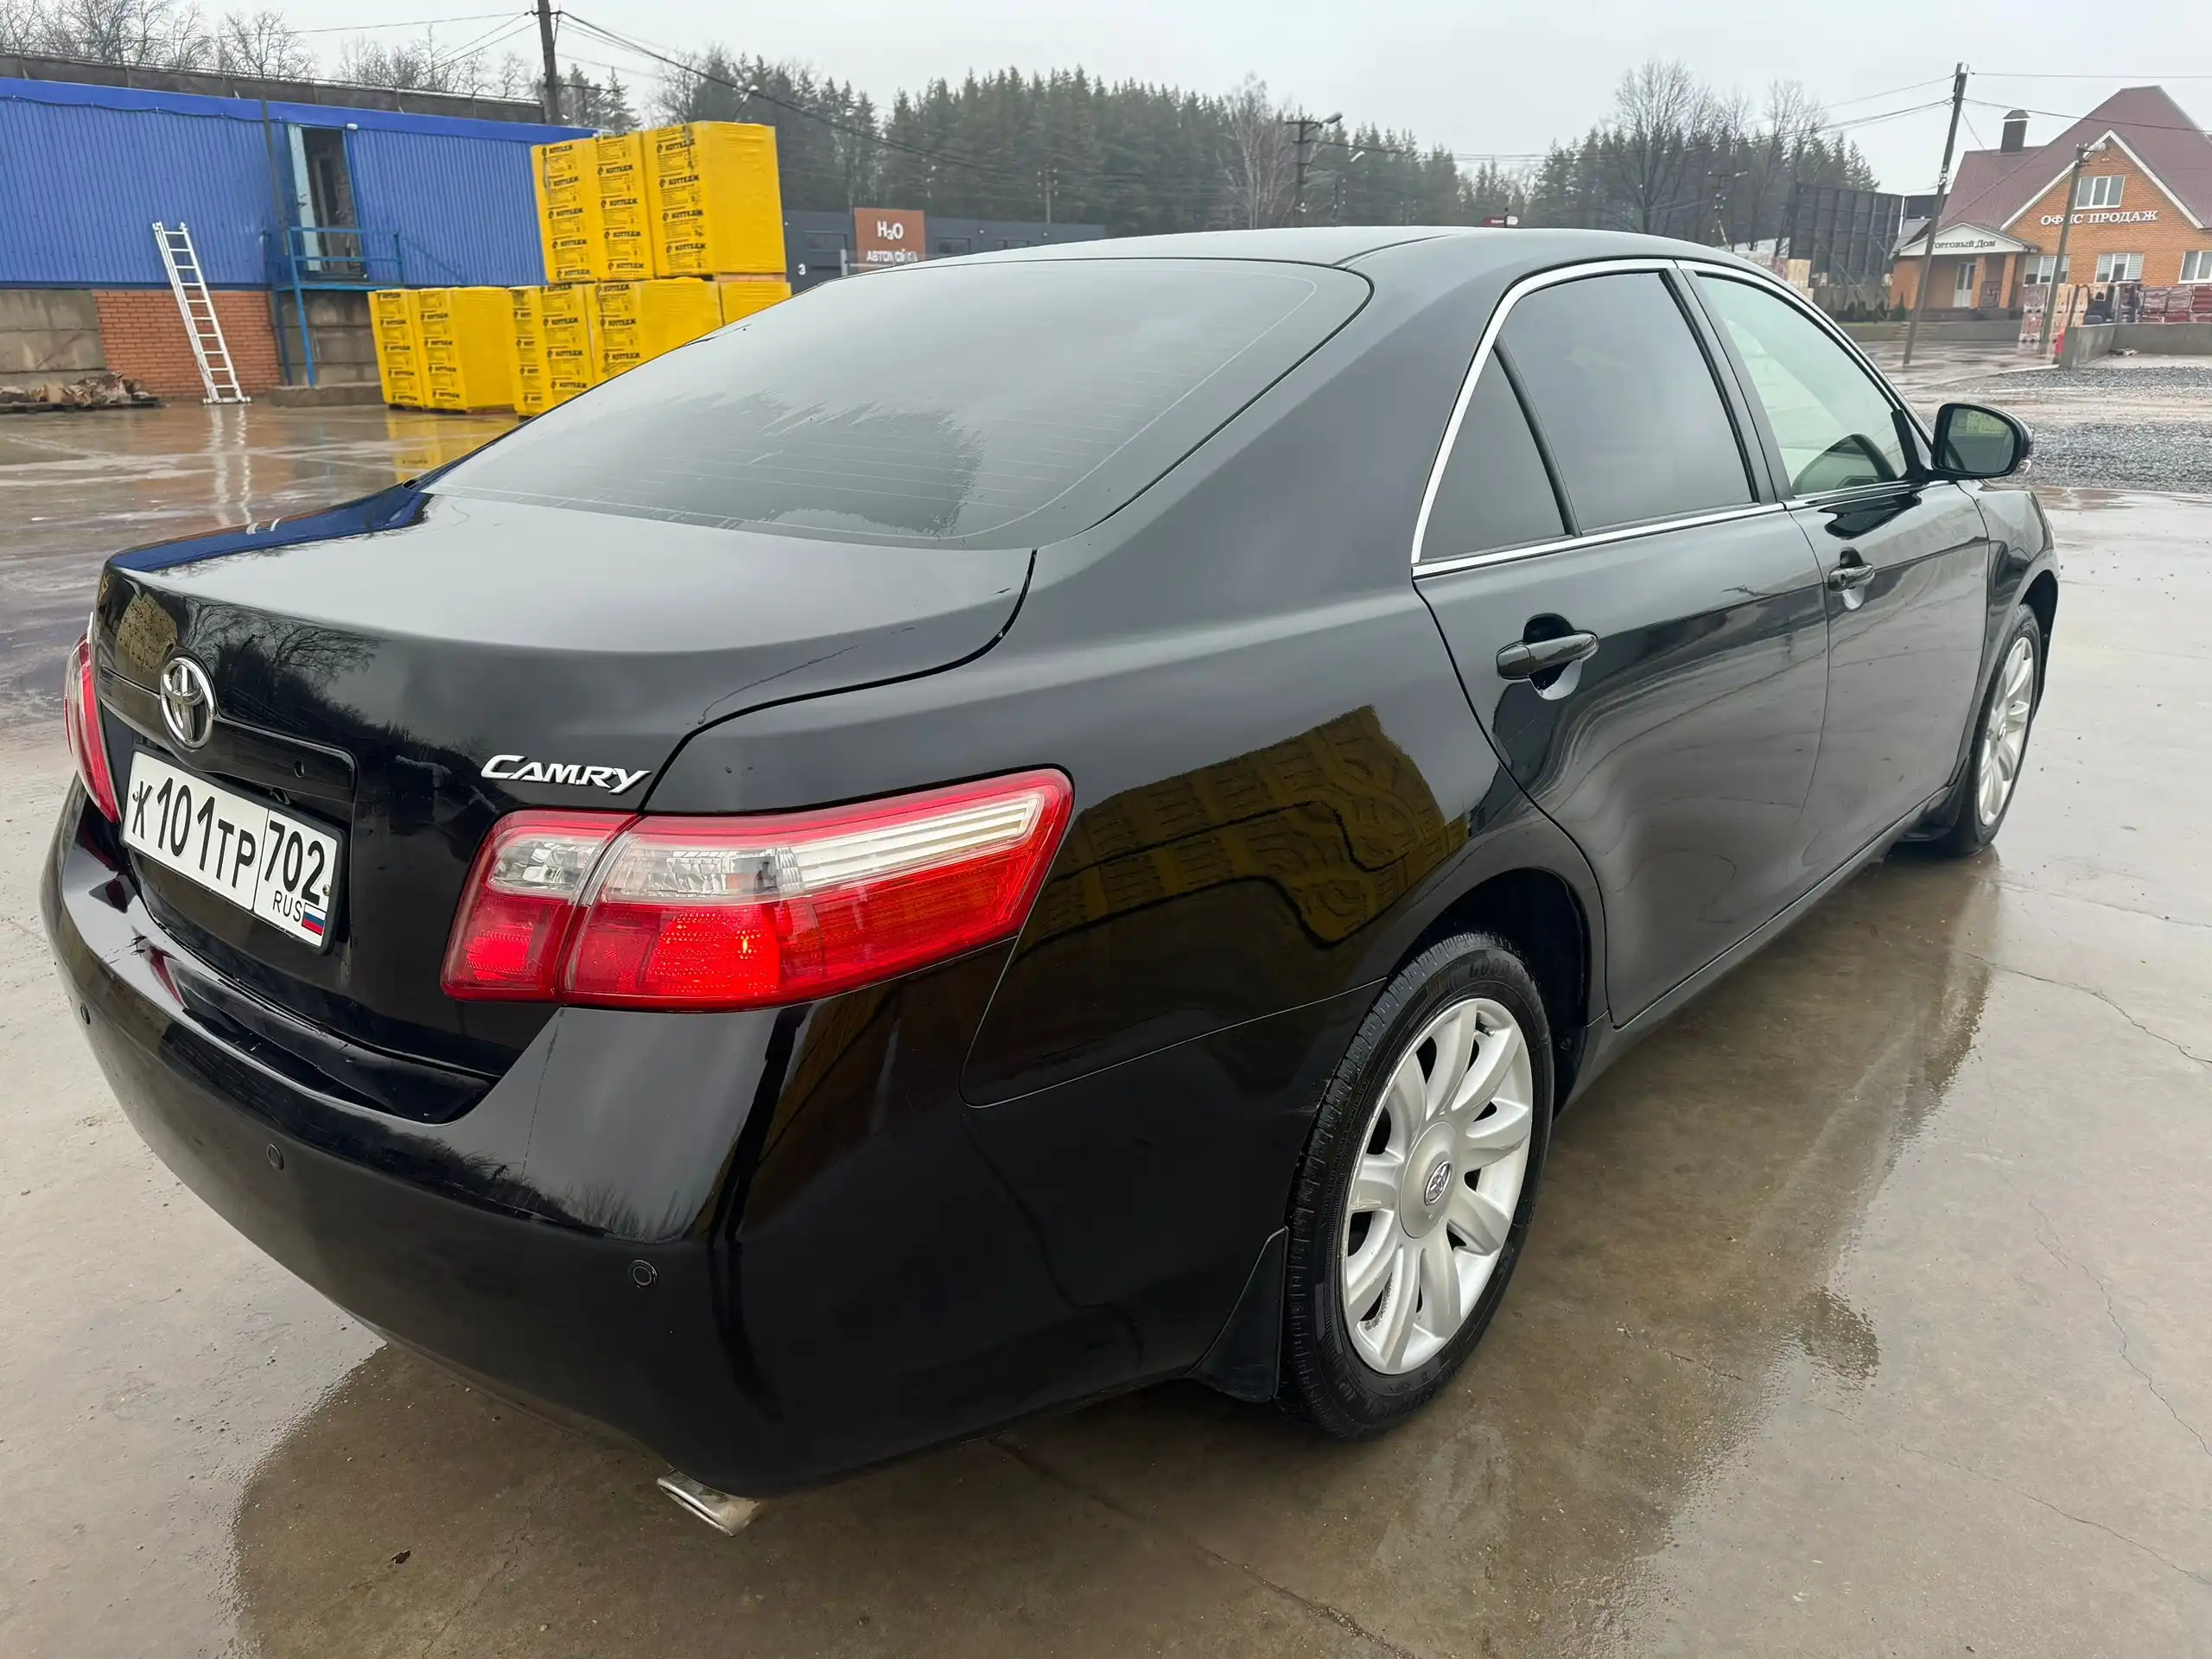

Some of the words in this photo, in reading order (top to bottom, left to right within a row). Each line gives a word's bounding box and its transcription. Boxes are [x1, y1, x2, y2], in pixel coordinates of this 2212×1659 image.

[2088, 211, 2158, 224] ПРОДАЖ
[481, 754, 652, 796] CAMRY
[264, 819, 326, 906] 702
[272, 890, 302, 923] RUS
